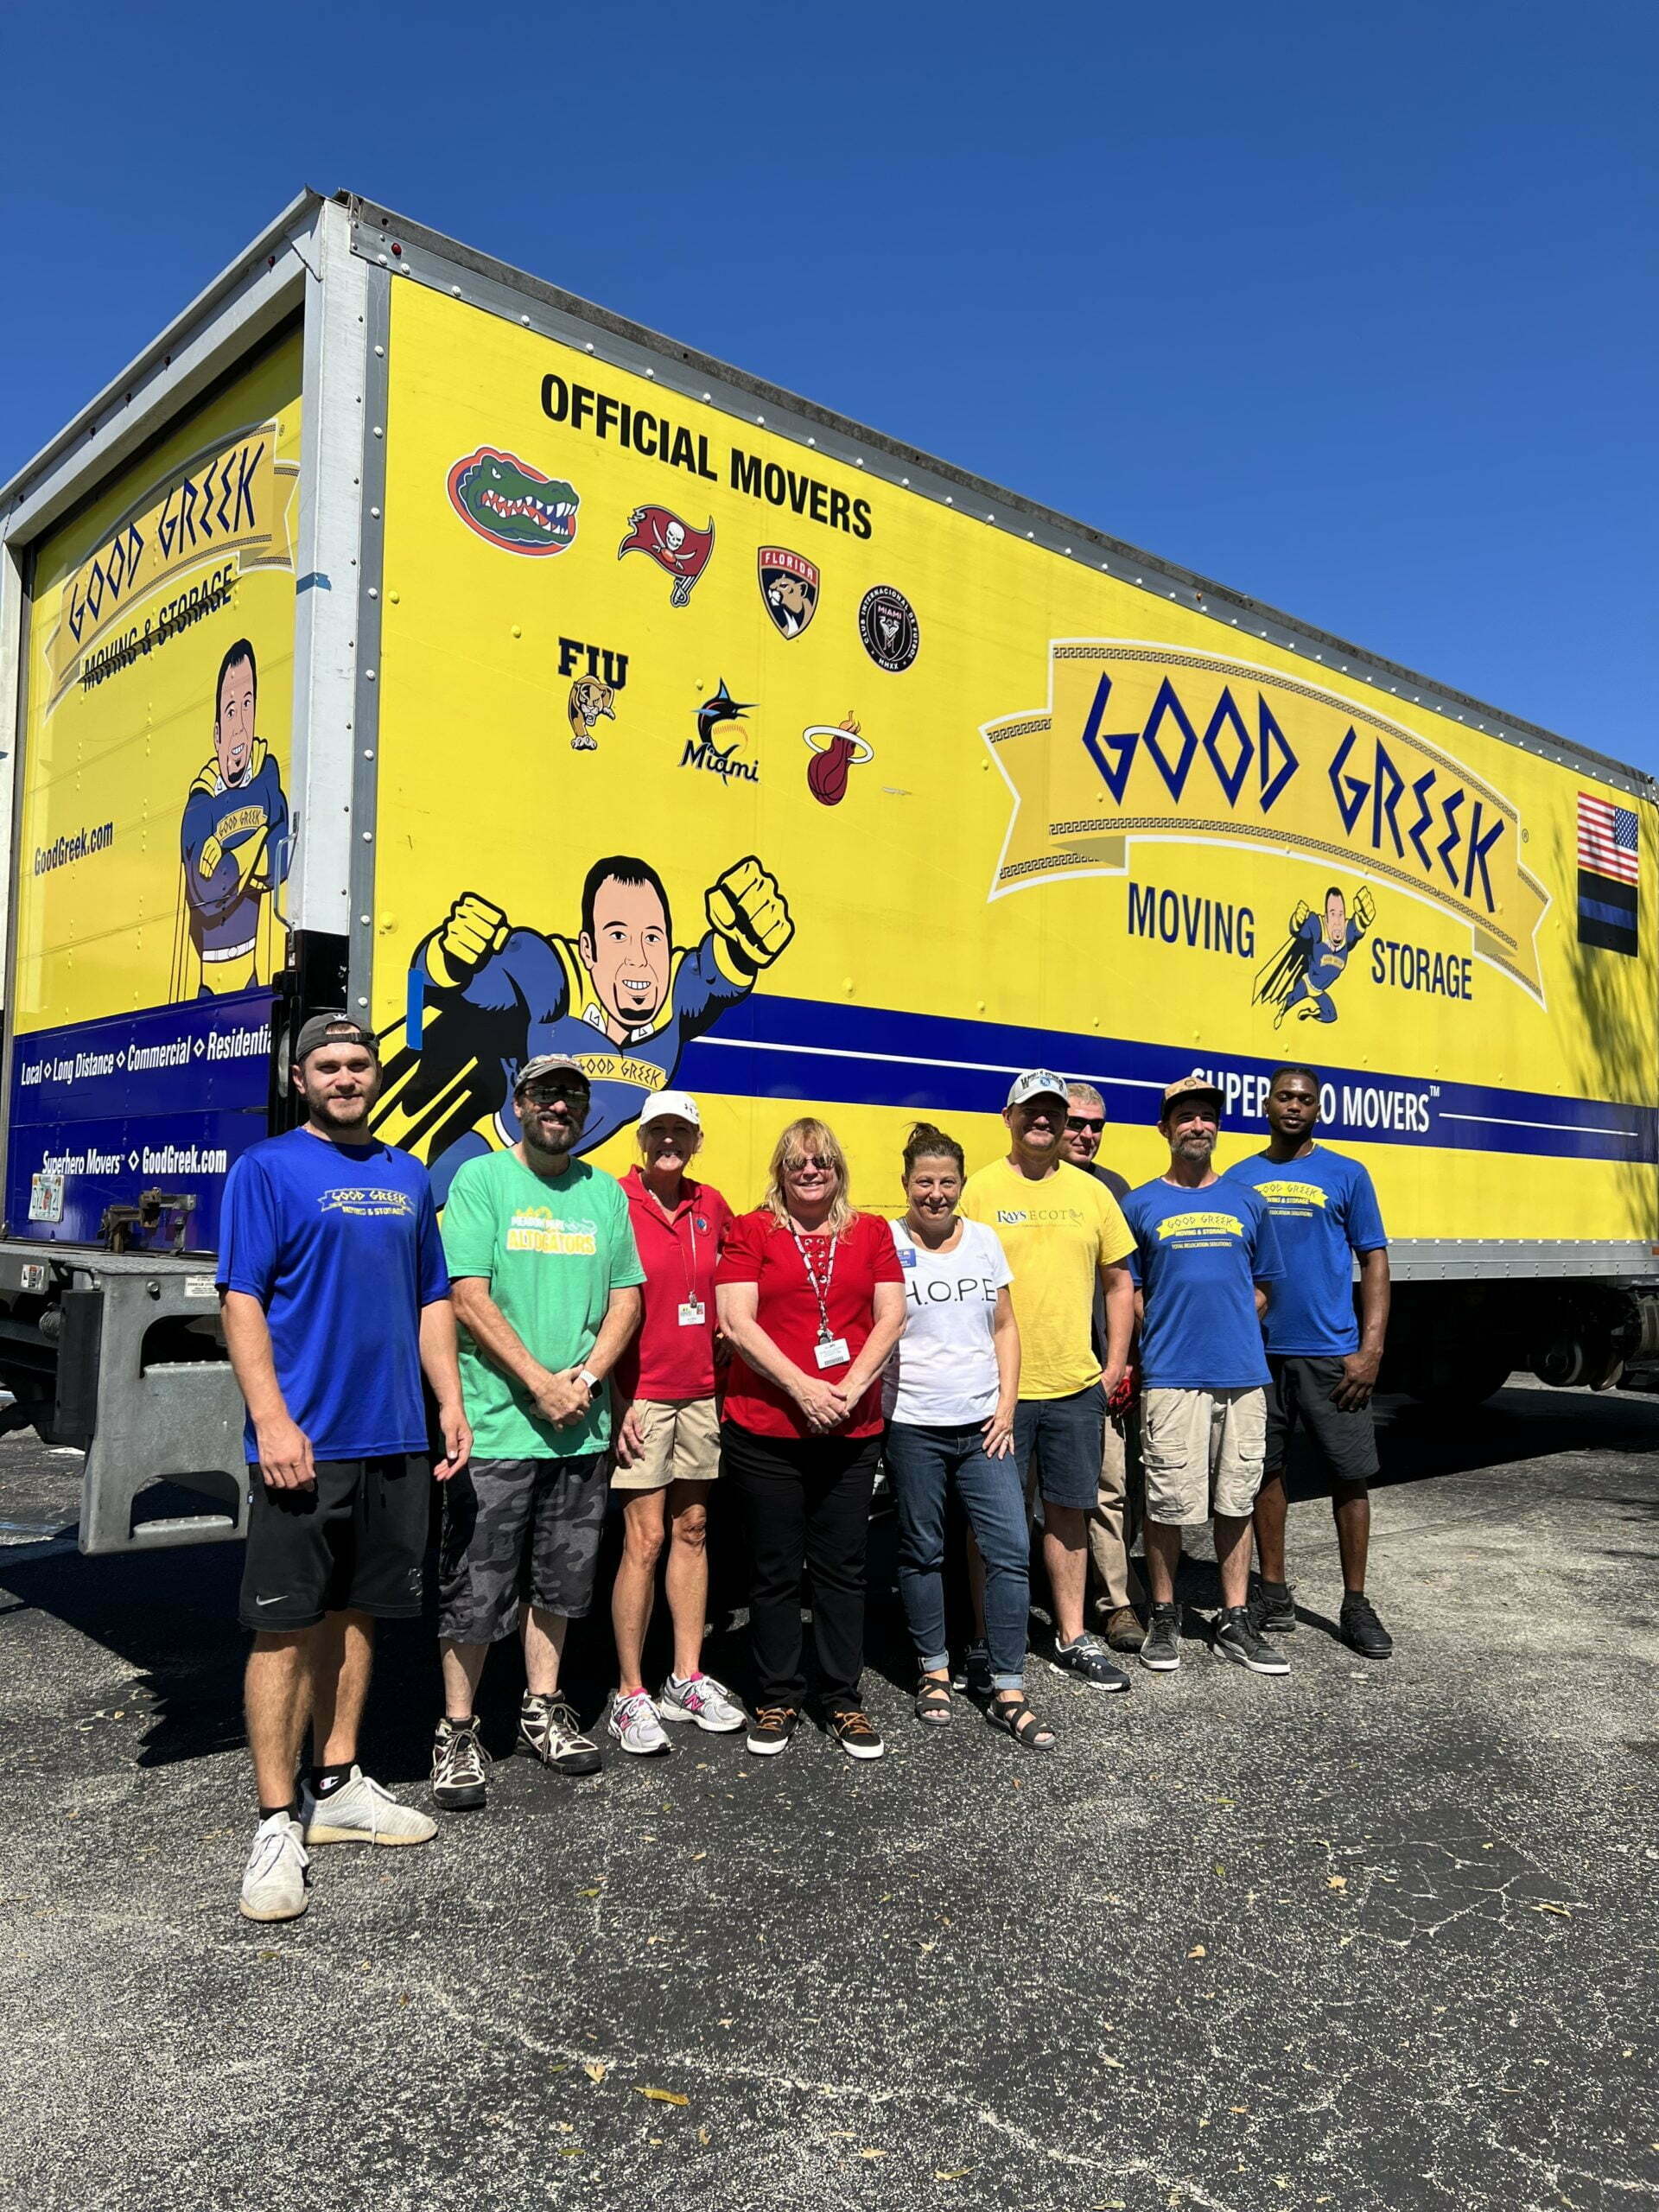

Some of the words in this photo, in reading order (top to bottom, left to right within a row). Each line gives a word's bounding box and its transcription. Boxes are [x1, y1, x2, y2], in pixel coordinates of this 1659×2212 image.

[541, 373, 717, 481] OFFICIAL
[730, 447, 872, 540] MOVERS
[68, 520, 144, 644] GOOD
[157, 442, 264, 560] GREEK
[765, 552, 814, 580] FLORIDA
[877, 606, 902, 620] MIAMI
[558, 636, 628, 690] FIU
[677, 739, 760, 783] Miami
[1082, 671, 1300, 814] GOOD
[1328, 724, 1505, 913] GREEK
[35, 821, 114, 876] GoodGreek.com
[1128, 882, 1255, 958] MOVING
[1371, 937, 1472, 1001] STORAGE
[21, 1059, 43, 1086] Local
[53, 1057, 74, 1084] Long
[75, 1052, 114, 1078] Distance
[127, 1035, 191, 1071] Commercial
[621, 1060, 662, 1088] GREEK
[41, 1148, 85, 1174] Superhero
[143, 1144, 227, 1174] GoodGreek.com
